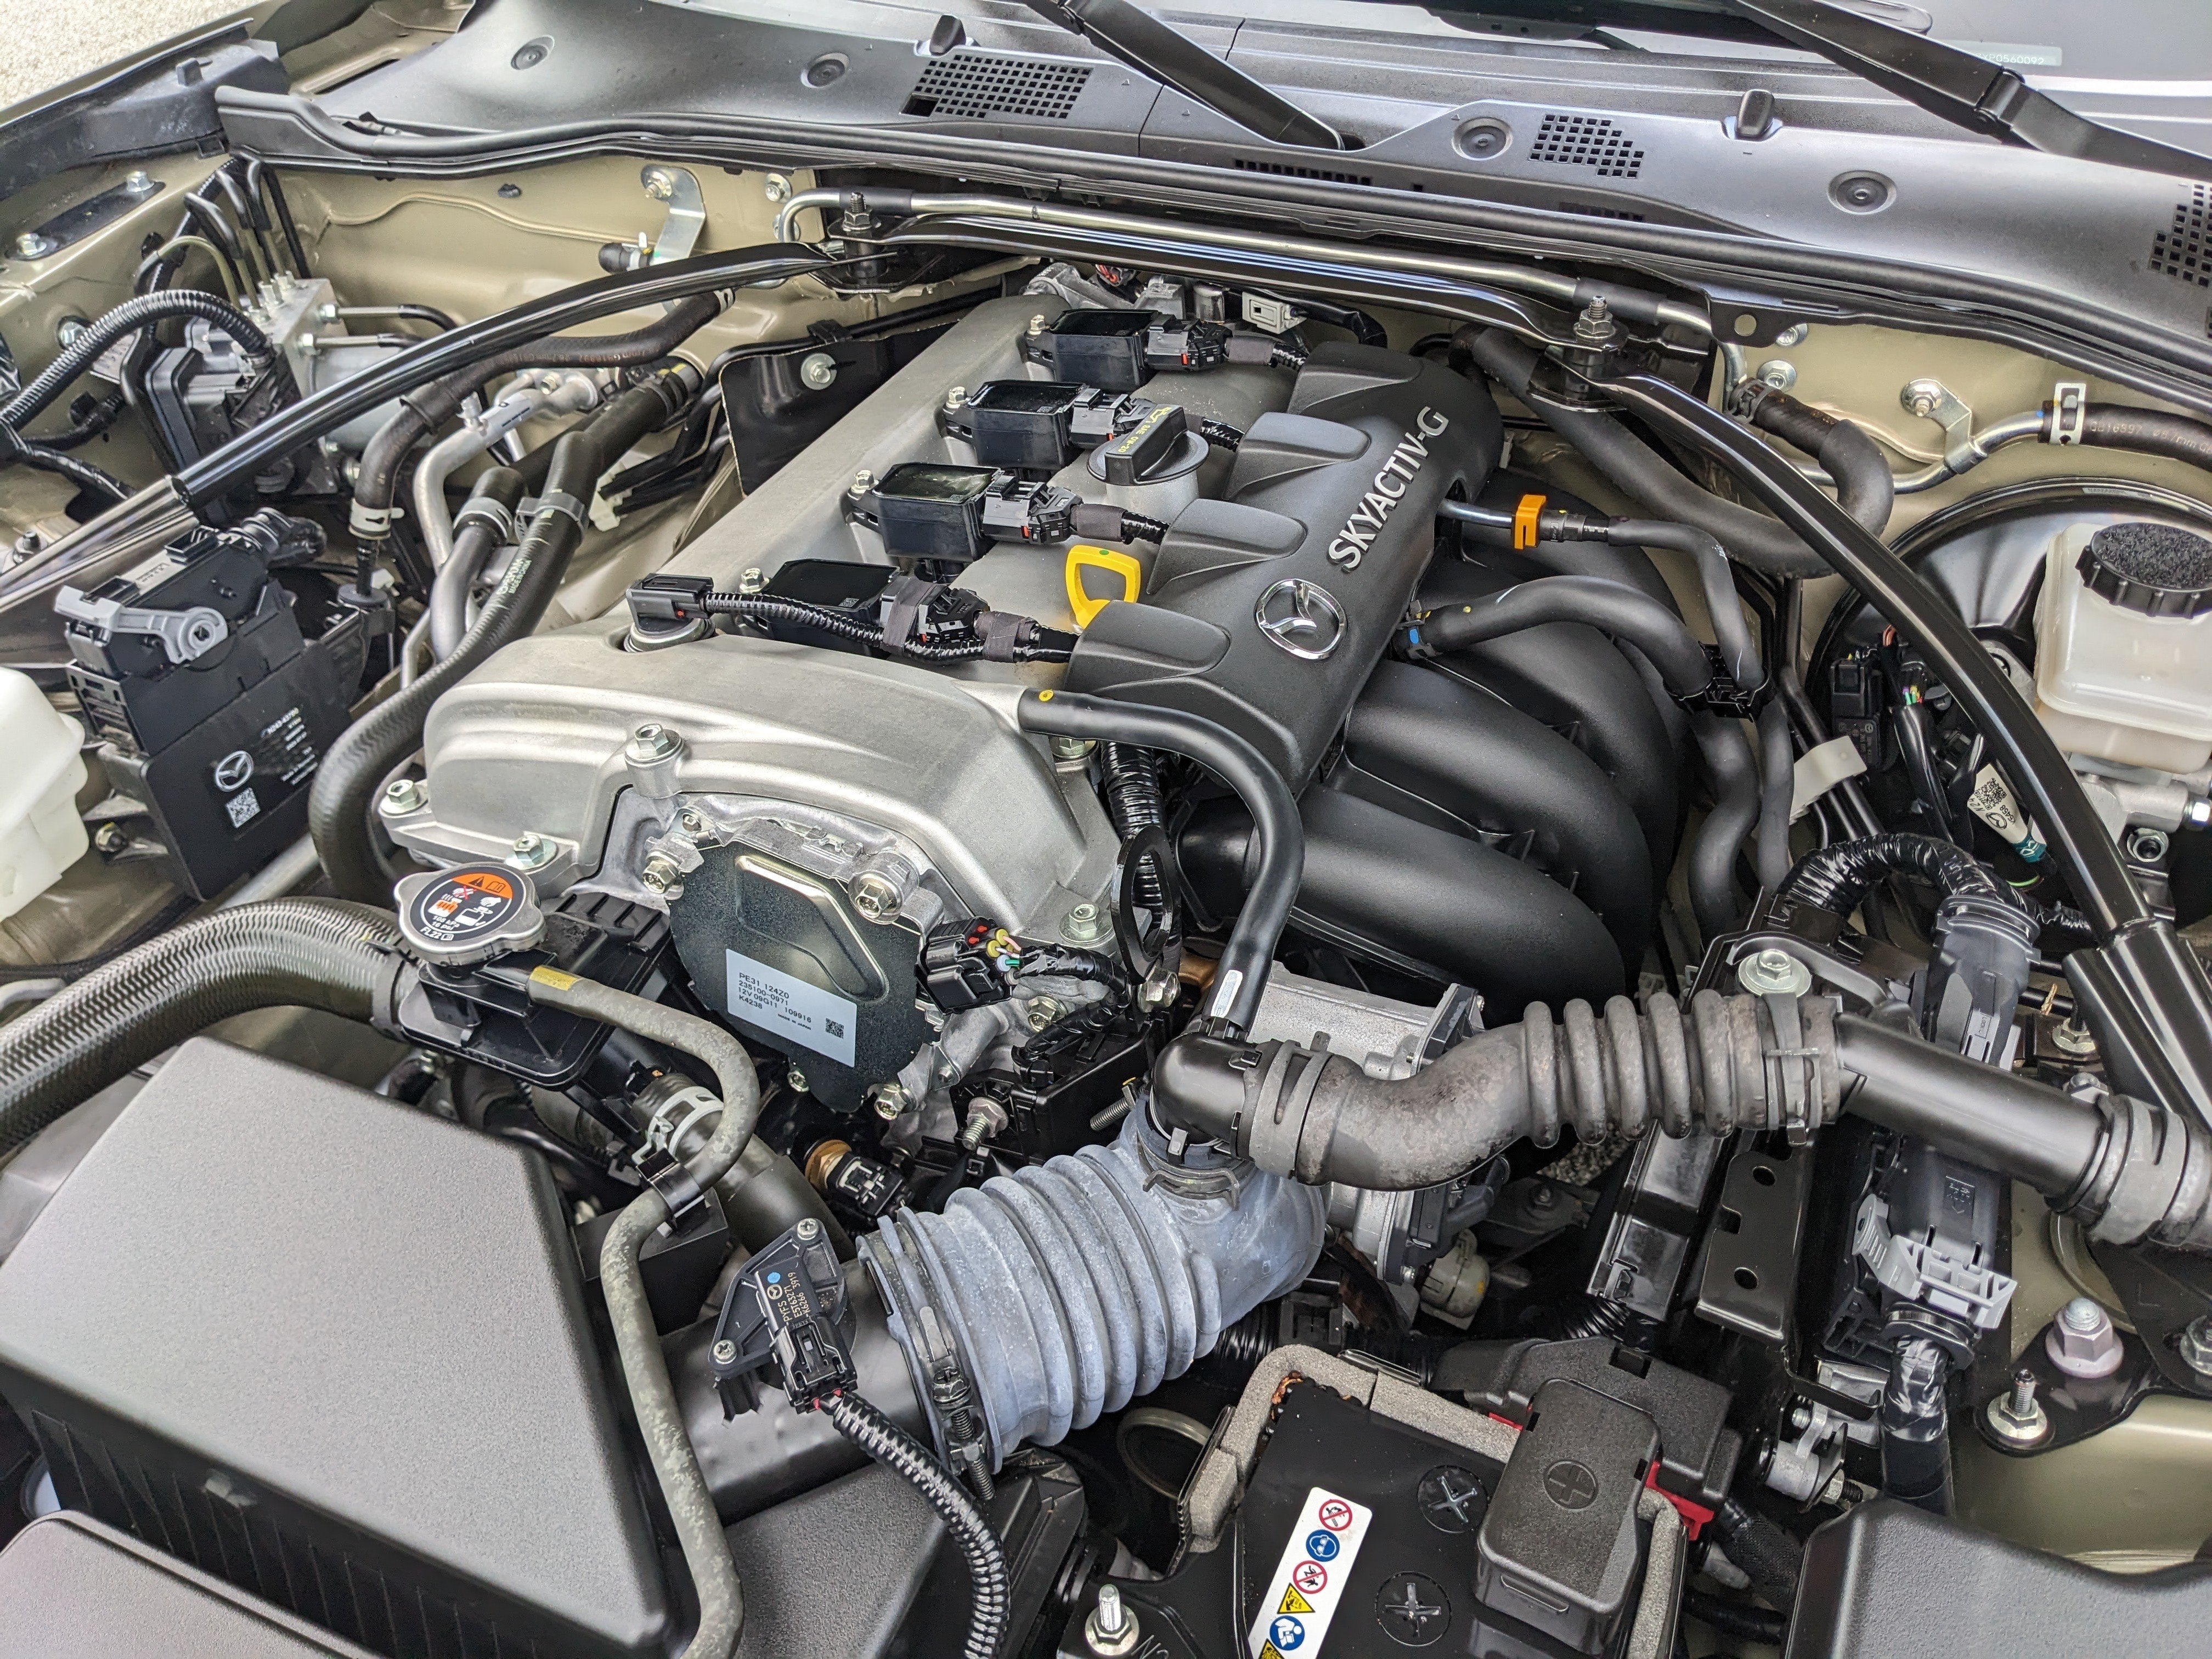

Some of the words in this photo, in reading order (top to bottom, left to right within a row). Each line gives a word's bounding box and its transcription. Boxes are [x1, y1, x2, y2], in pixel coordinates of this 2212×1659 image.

[1135, 425, 1150, 435] SAE
[1118, 437, 1139, 453] 0W-20
[1328, 406, 1449, 571] SKYACTIV-G
[420, 926, 442, 939] FL22
[739, 972, 759, 986] PE31
[738, 980, 788, 1006] 235100-0971
[738, 995, 763, 1009] K4238
[738, 987, 752, 996] 12V
[754, 994, 777, 1008] 09G11
[785, 1007, 811, 1023] 109916
[788, 1272, 800, 1289] 3919
[777, 1300, 793, 1322] PYFS
[783, 1285, 803, 1318] E5T63271
[796, 1292, 811, 1314] K6266
